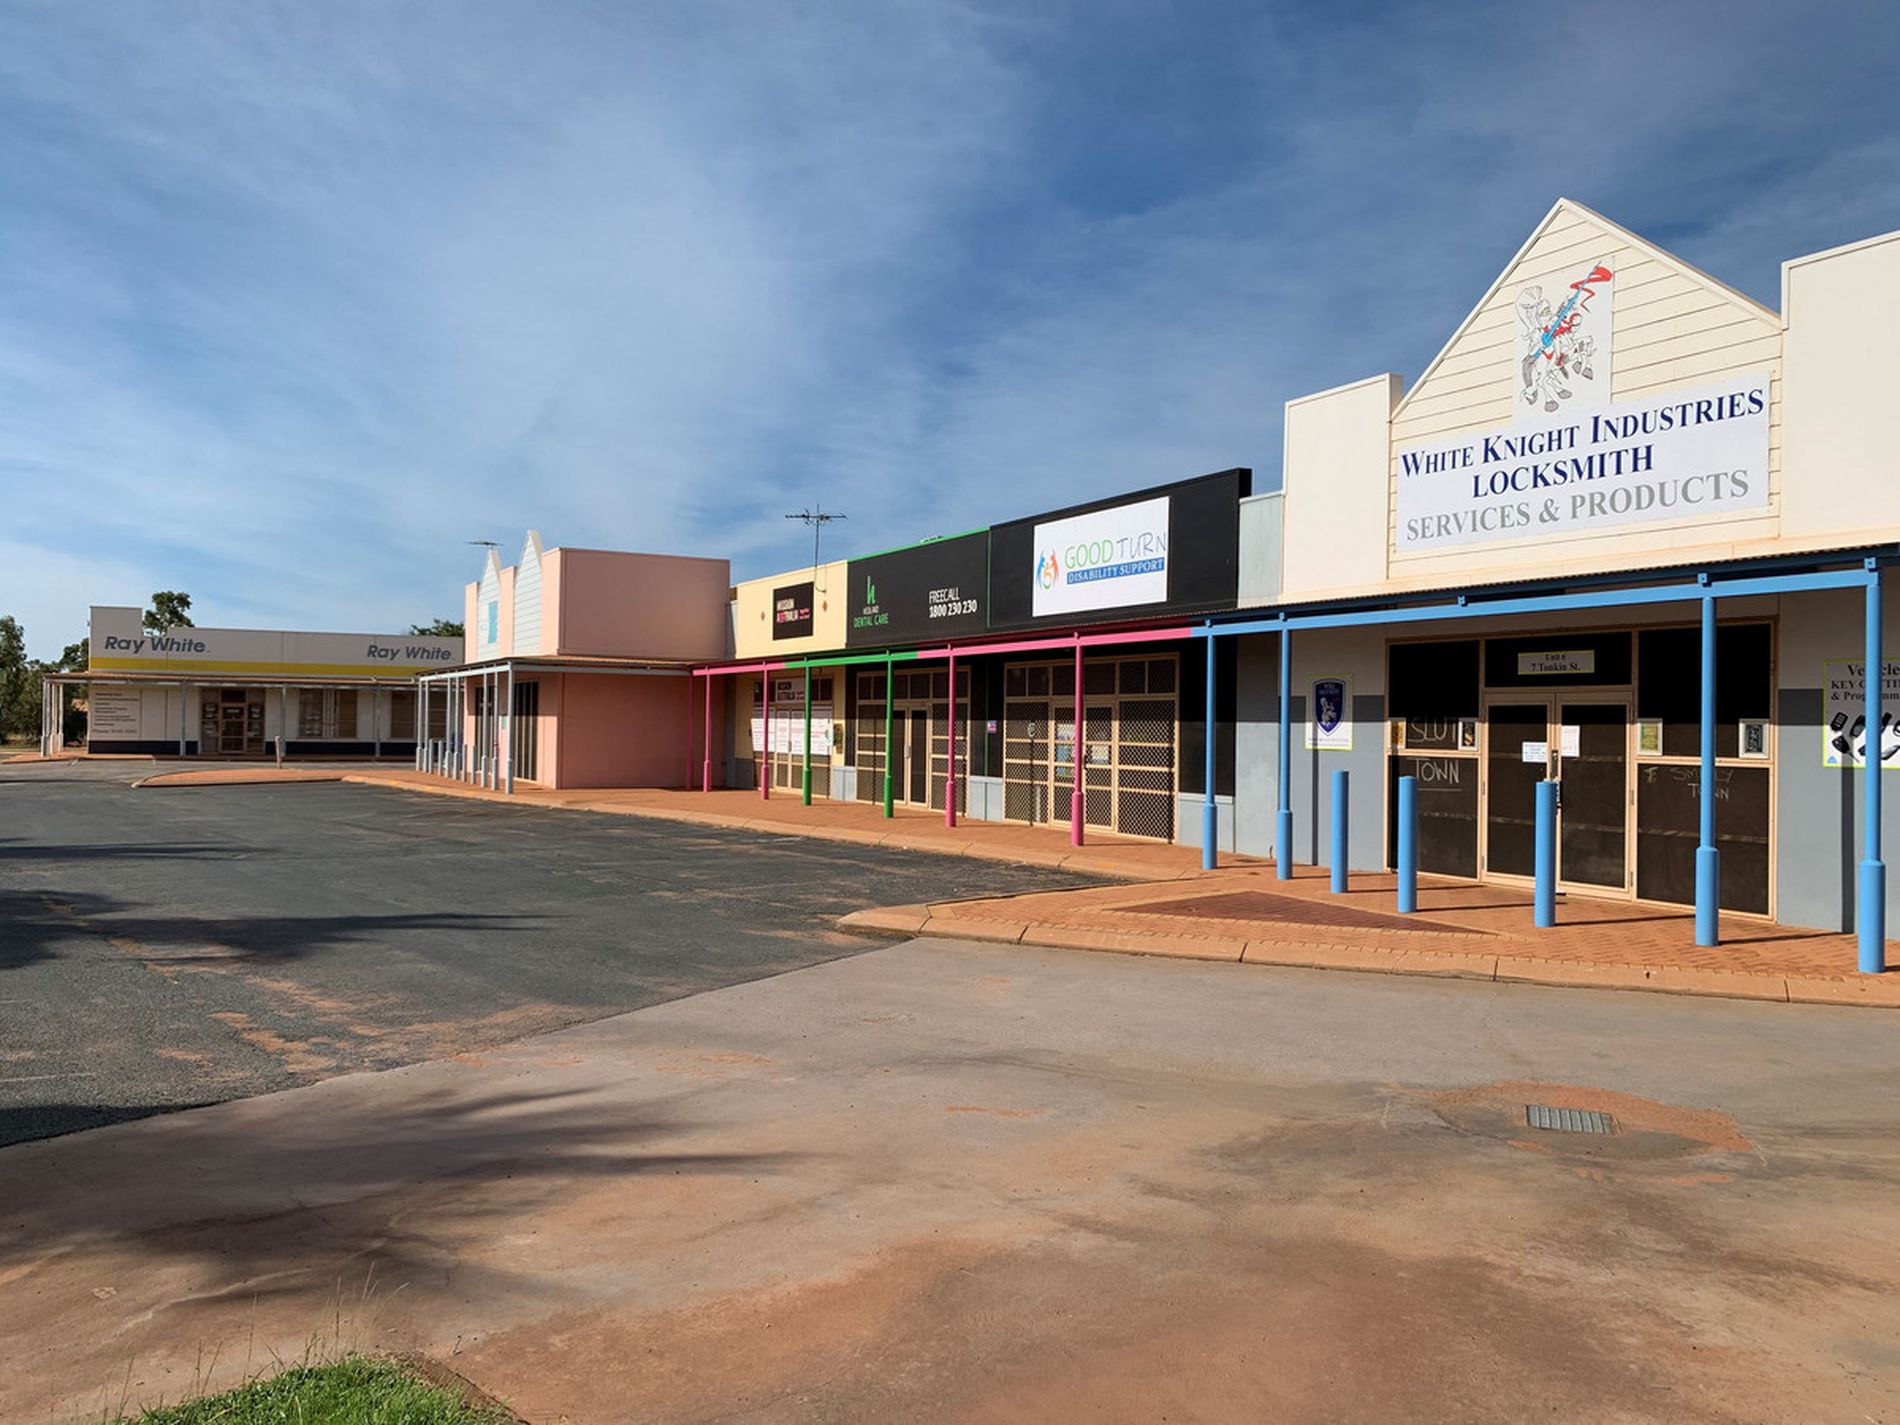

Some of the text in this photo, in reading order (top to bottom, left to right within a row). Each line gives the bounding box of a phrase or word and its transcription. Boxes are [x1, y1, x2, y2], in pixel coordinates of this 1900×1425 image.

[1473, 445, 1654, 498] LOCKSMITH
[1407, 469, 1749, 541] SERVICES & PRODUCTS
[1065, 532, 1166, 569] GOOD TURN
[1068, 559, 1164, 583] DISABILITY SUPPORT
[929, 587, 960, 604] FREECALL
[929, 599, 977, 618] 1800 230 230
[104, 636, 206, 654] Ray White
[367, 645, 452, 661] Ray White
[1830, 679, 1855, 690] KEY
[1830, 691, 1840, 701] &
[1406, 756, 1460, 784] TOWN
[1687, 783, 1729, 802] TN
